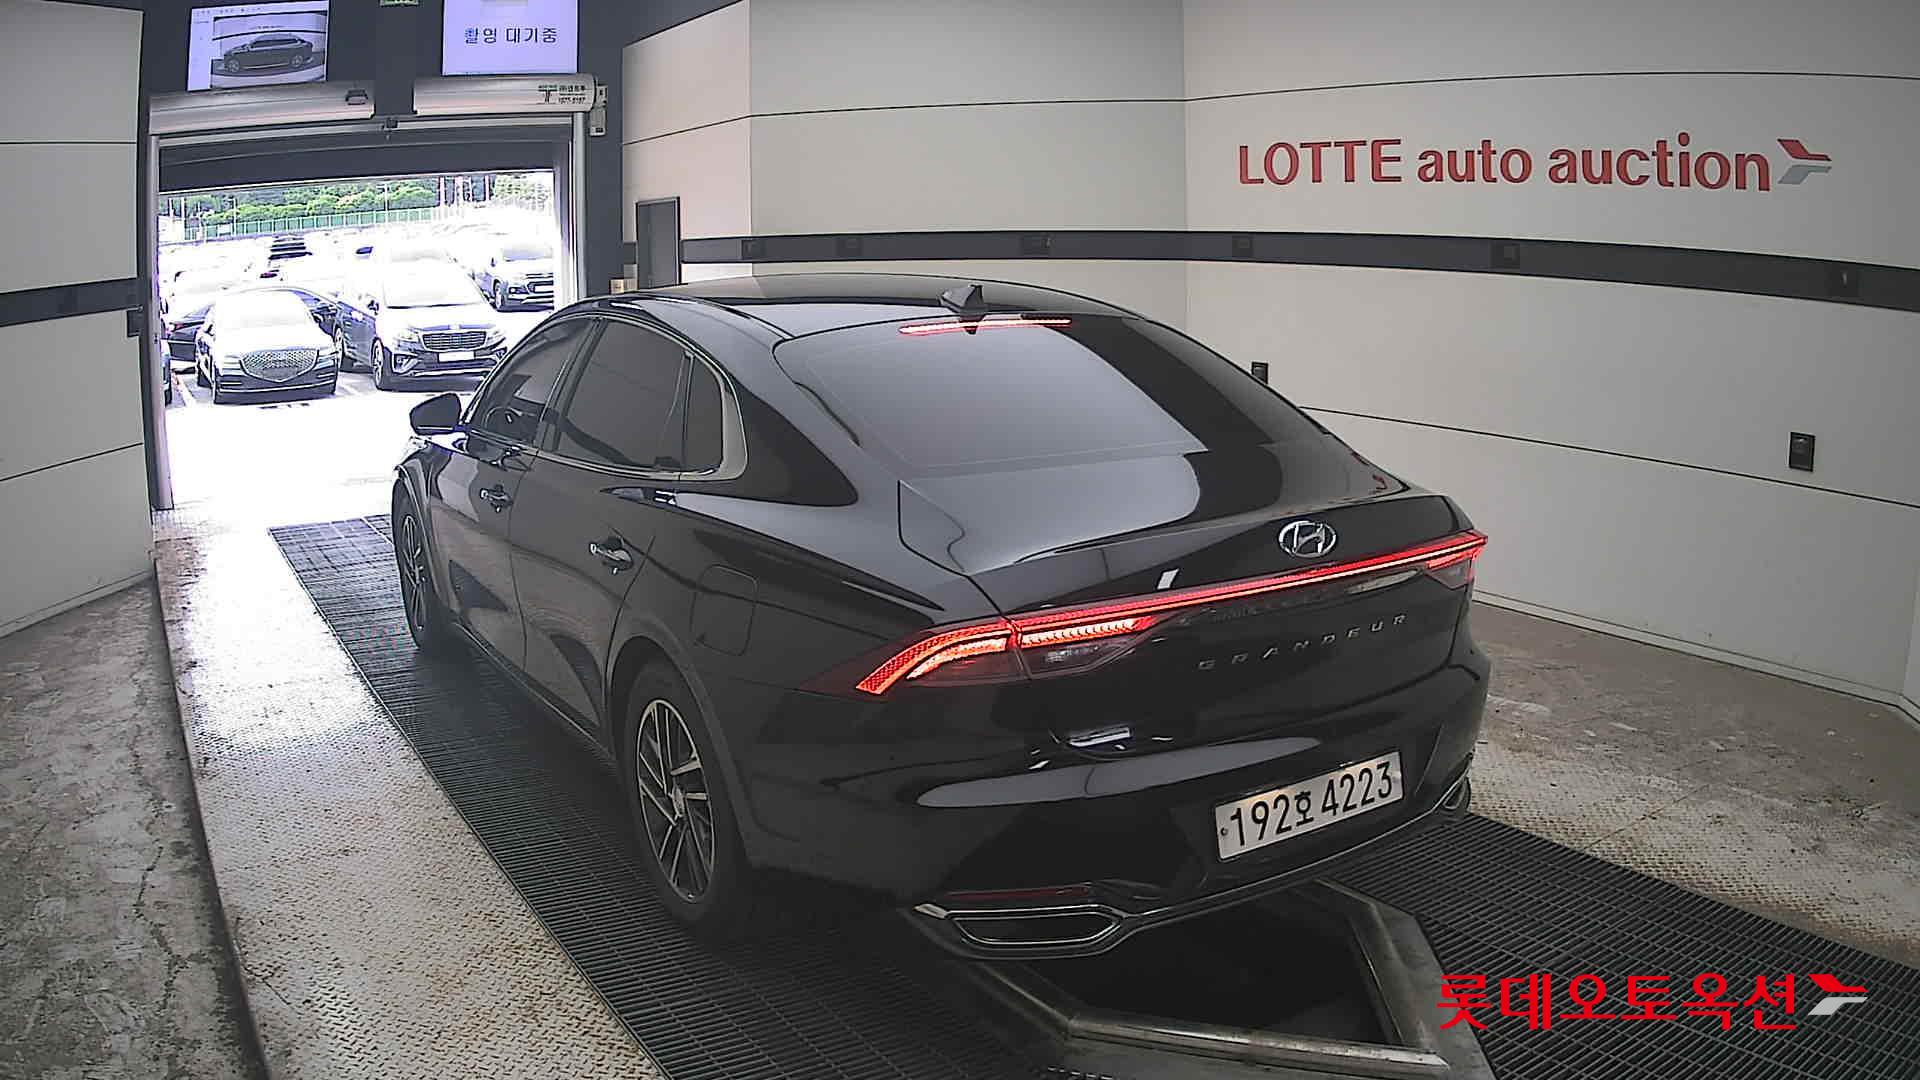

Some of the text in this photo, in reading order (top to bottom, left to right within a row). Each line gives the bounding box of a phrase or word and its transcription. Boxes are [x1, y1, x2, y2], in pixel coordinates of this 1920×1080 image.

[464, 27, 557, 45] 촬영 대기중
[1238, 131, 1771, 192] LOTTE auto auction
[1198, 613, 1407, 670] GRANDEUR
[1321, 760, 1393, 817] 4223
